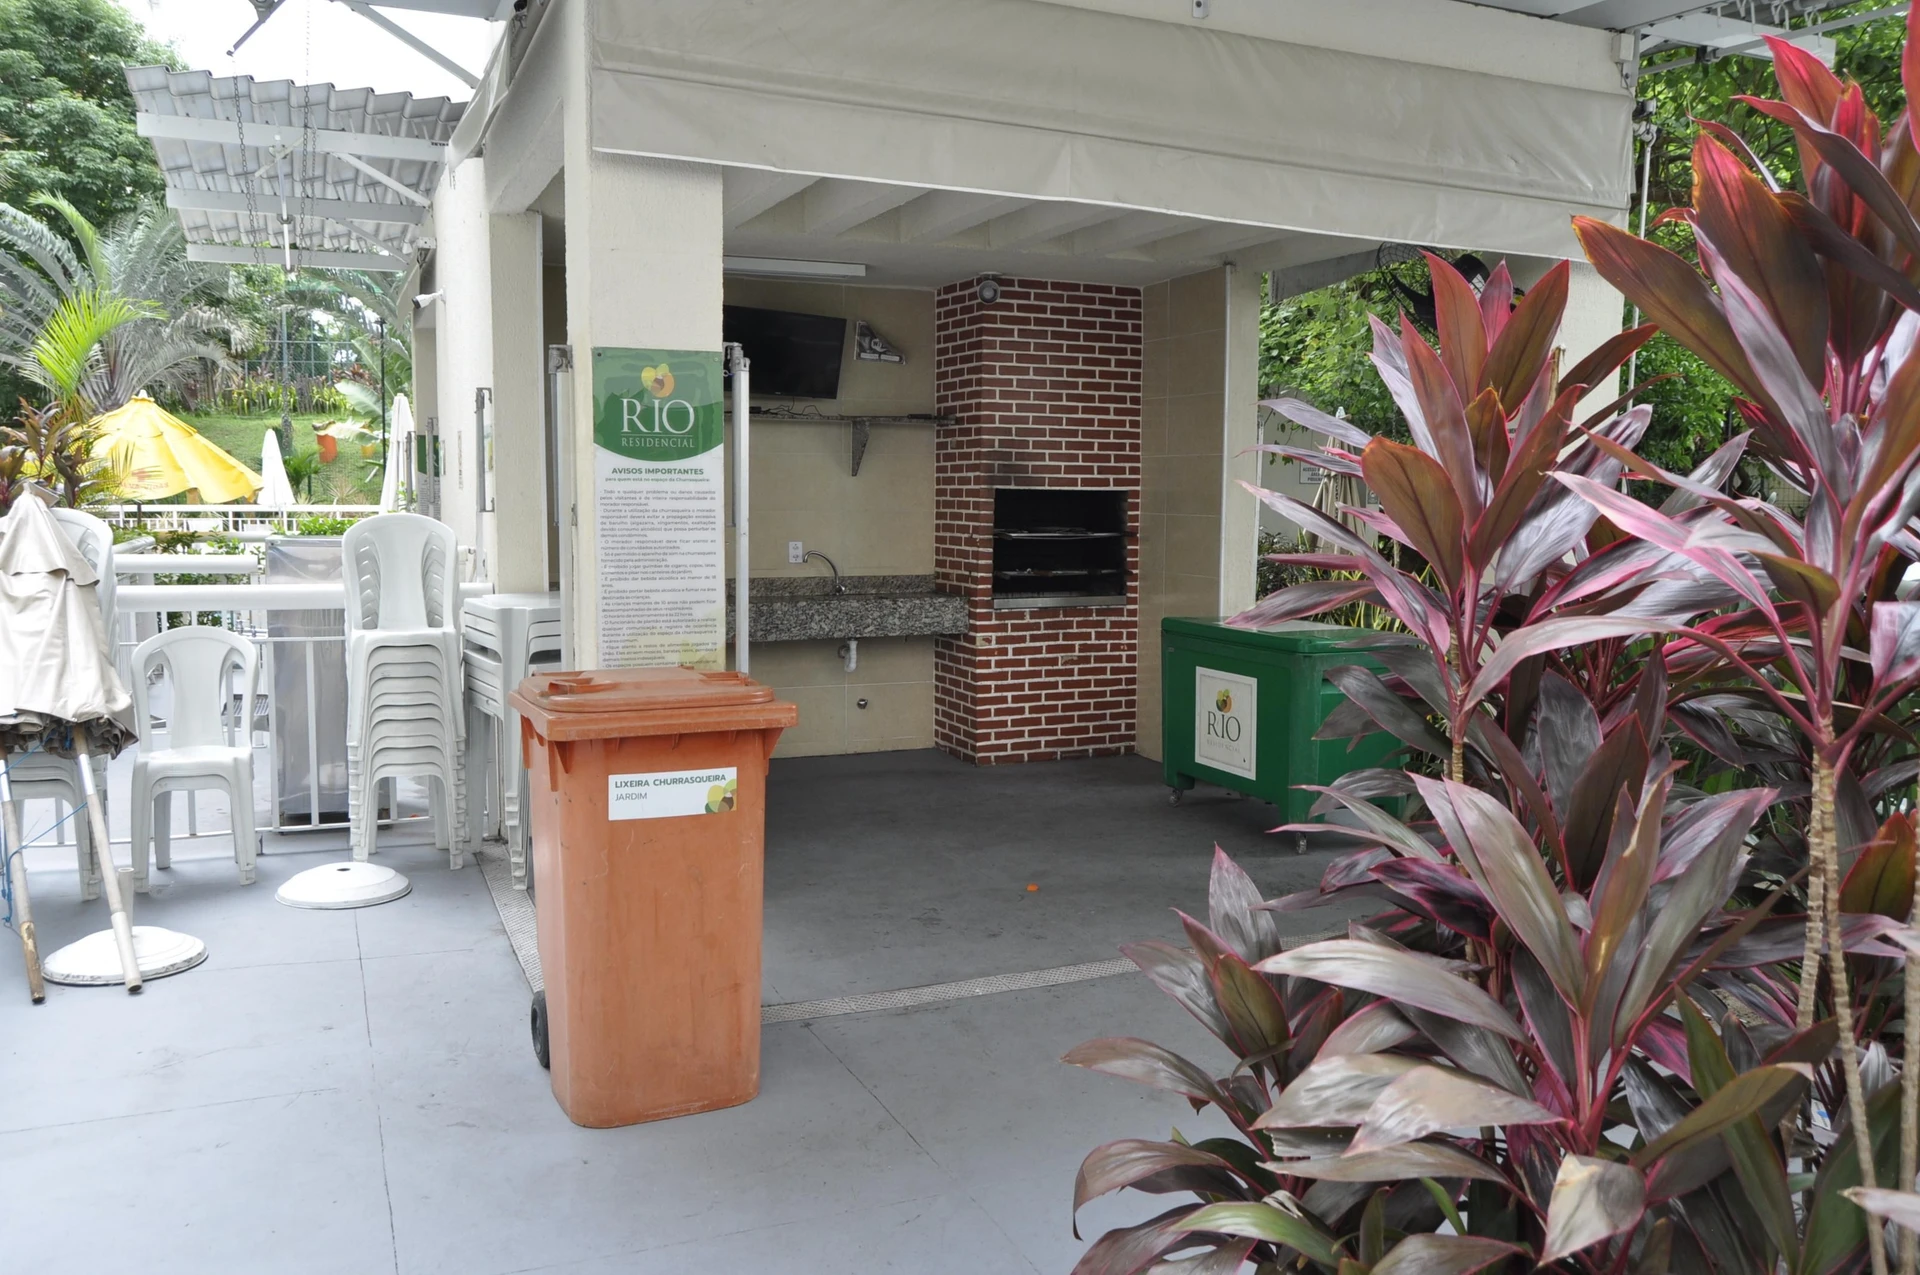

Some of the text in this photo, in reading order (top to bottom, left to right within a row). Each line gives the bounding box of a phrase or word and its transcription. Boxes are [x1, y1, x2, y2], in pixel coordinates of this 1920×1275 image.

[620, 398, 695, 434] RIO
[622, 438, 695, 448] RESIDENCIAL
[1207, 710, 1241, 742] RIO
[615, 774, 726, 788] LIXEIRA CHURRASQUEIRA
[615, 792, 648, 802] JARDIM
